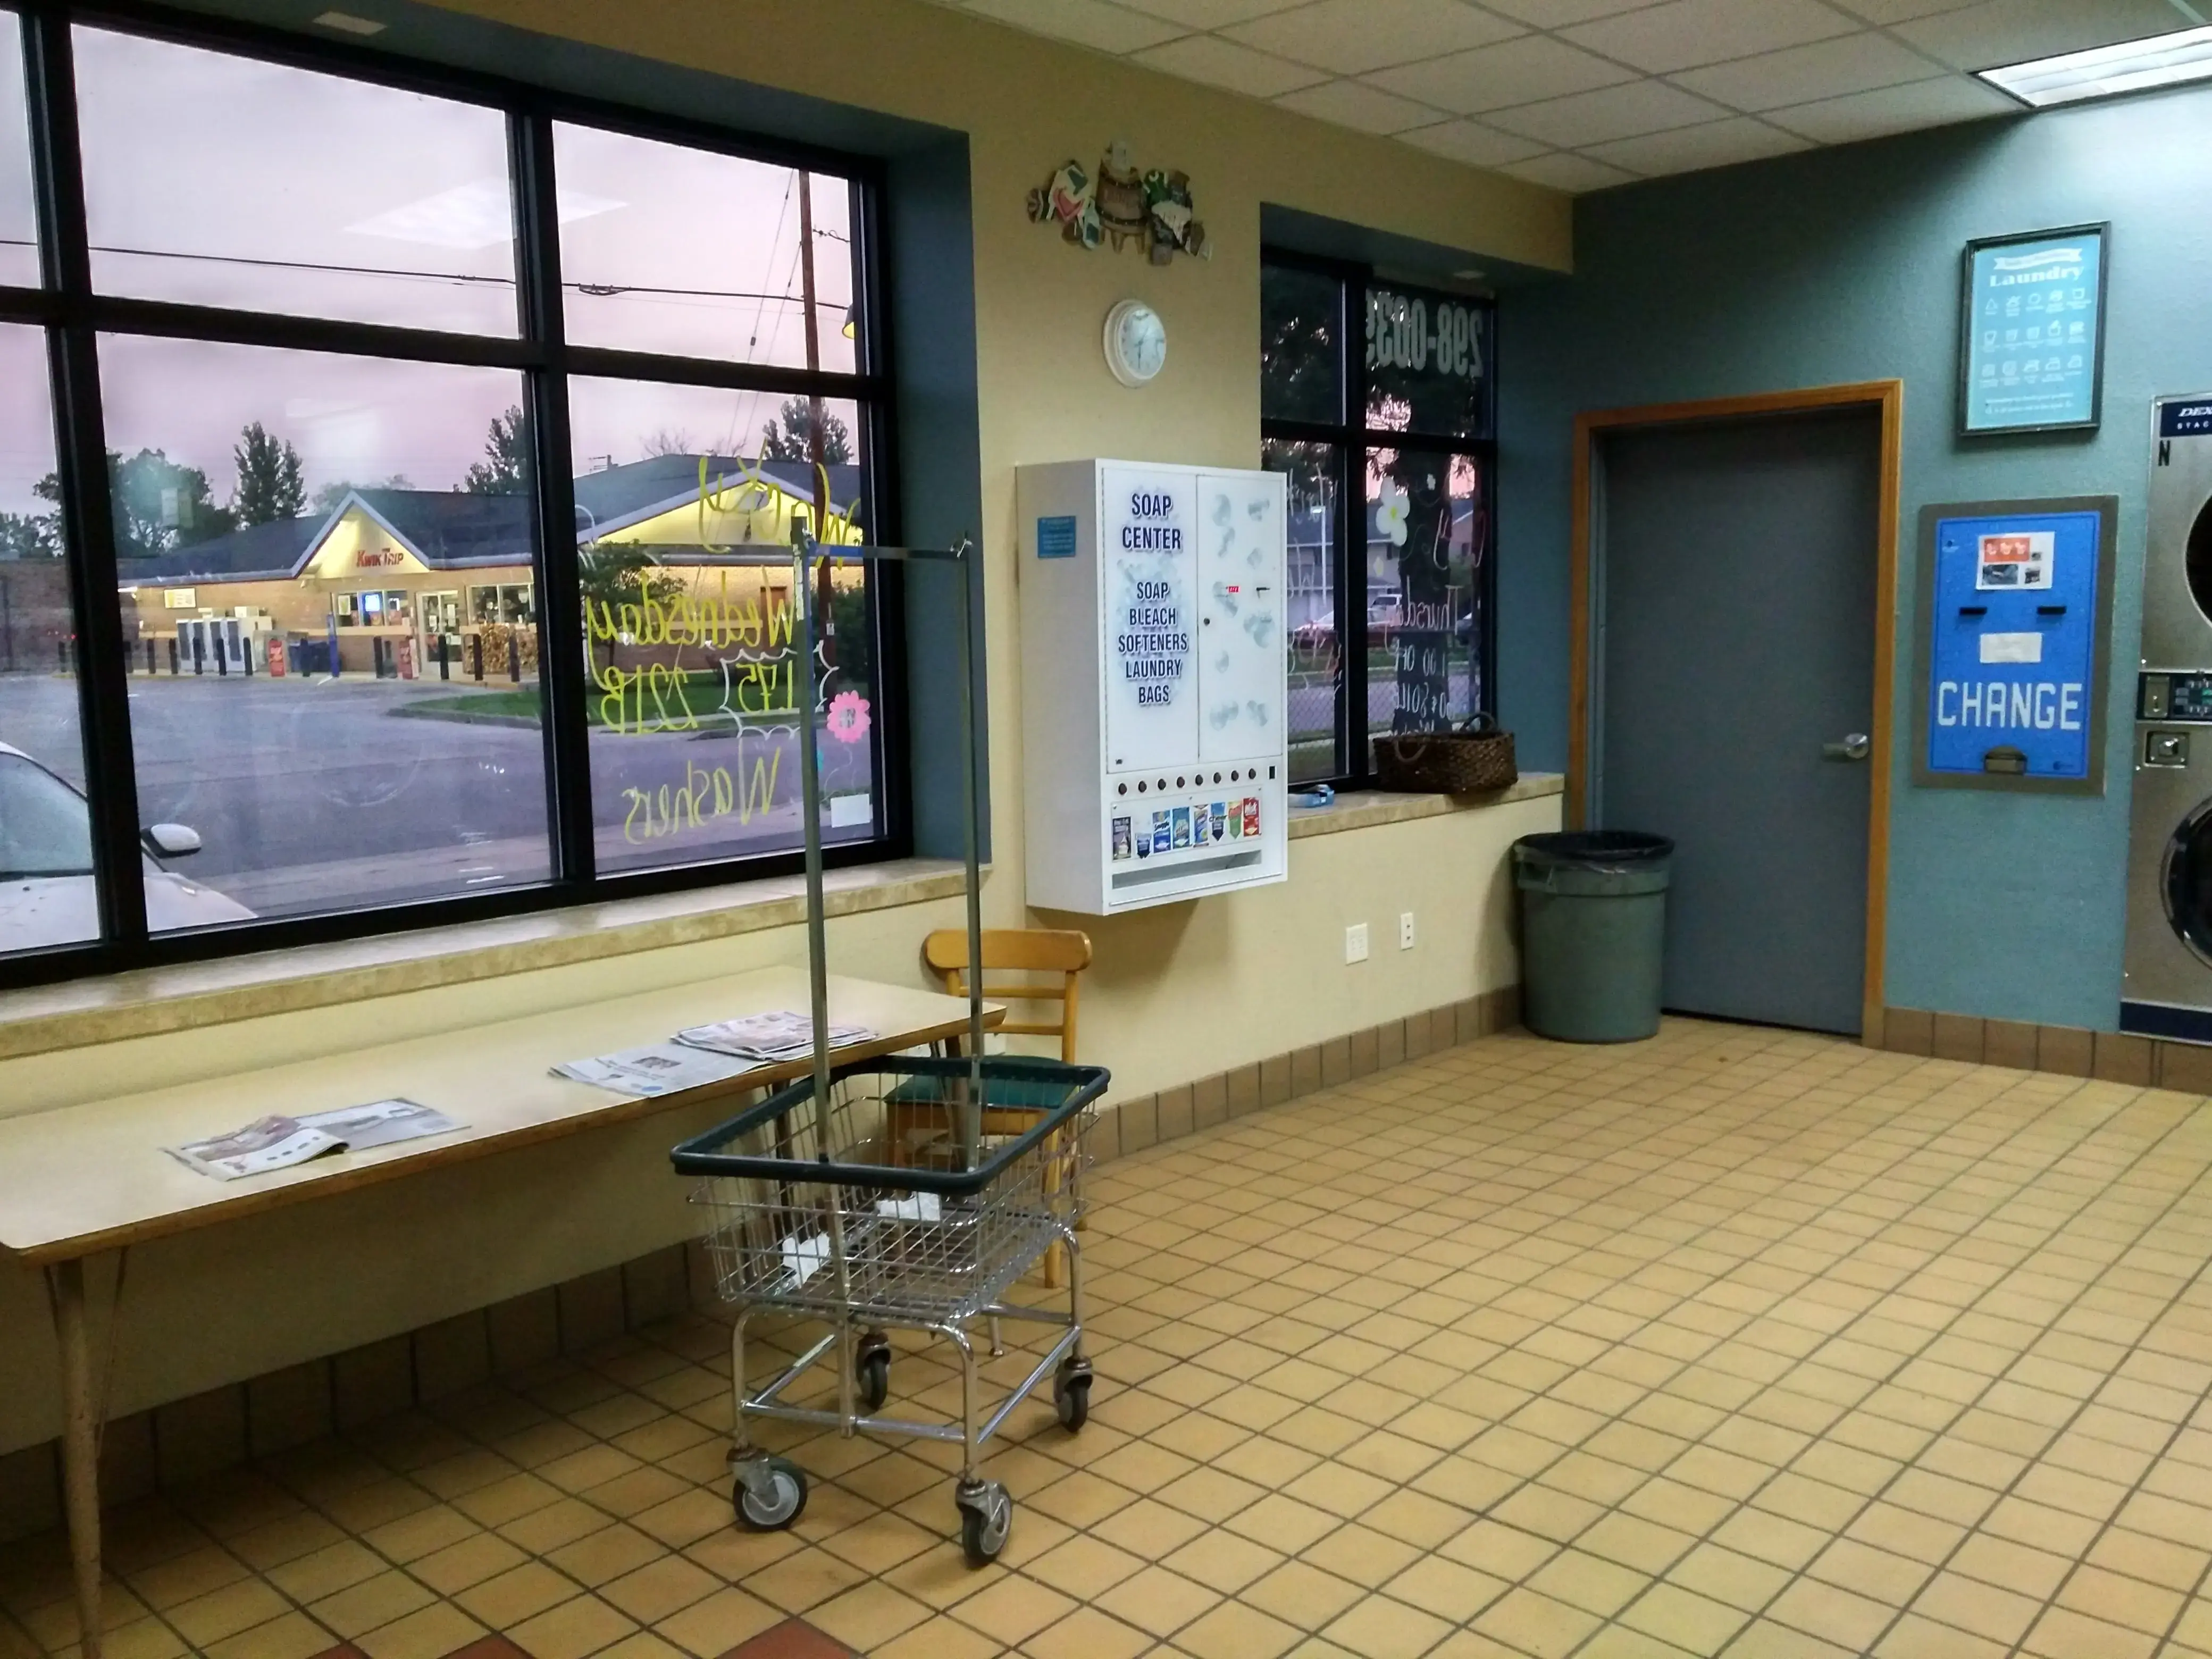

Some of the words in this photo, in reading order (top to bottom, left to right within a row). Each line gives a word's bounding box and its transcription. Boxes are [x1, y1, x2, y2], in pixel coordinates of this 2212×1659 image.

[1990, 266, 2084, 287] Laundry
[1131, 493, 1173, 518] SOAP
[1122, 526, 1182, 551] CENTER
[1137, 582, 1170, 600] SOAP
[1129, 608, 1177, 626] BLEACH
[1118, 633, 1188, 653] SOFTENERS
[1126, 659, 1182, 680] LAUNDRY
[1138, 685, 1170, 705] BAGS
[1937, 681, 2082, 730] CHANGE
